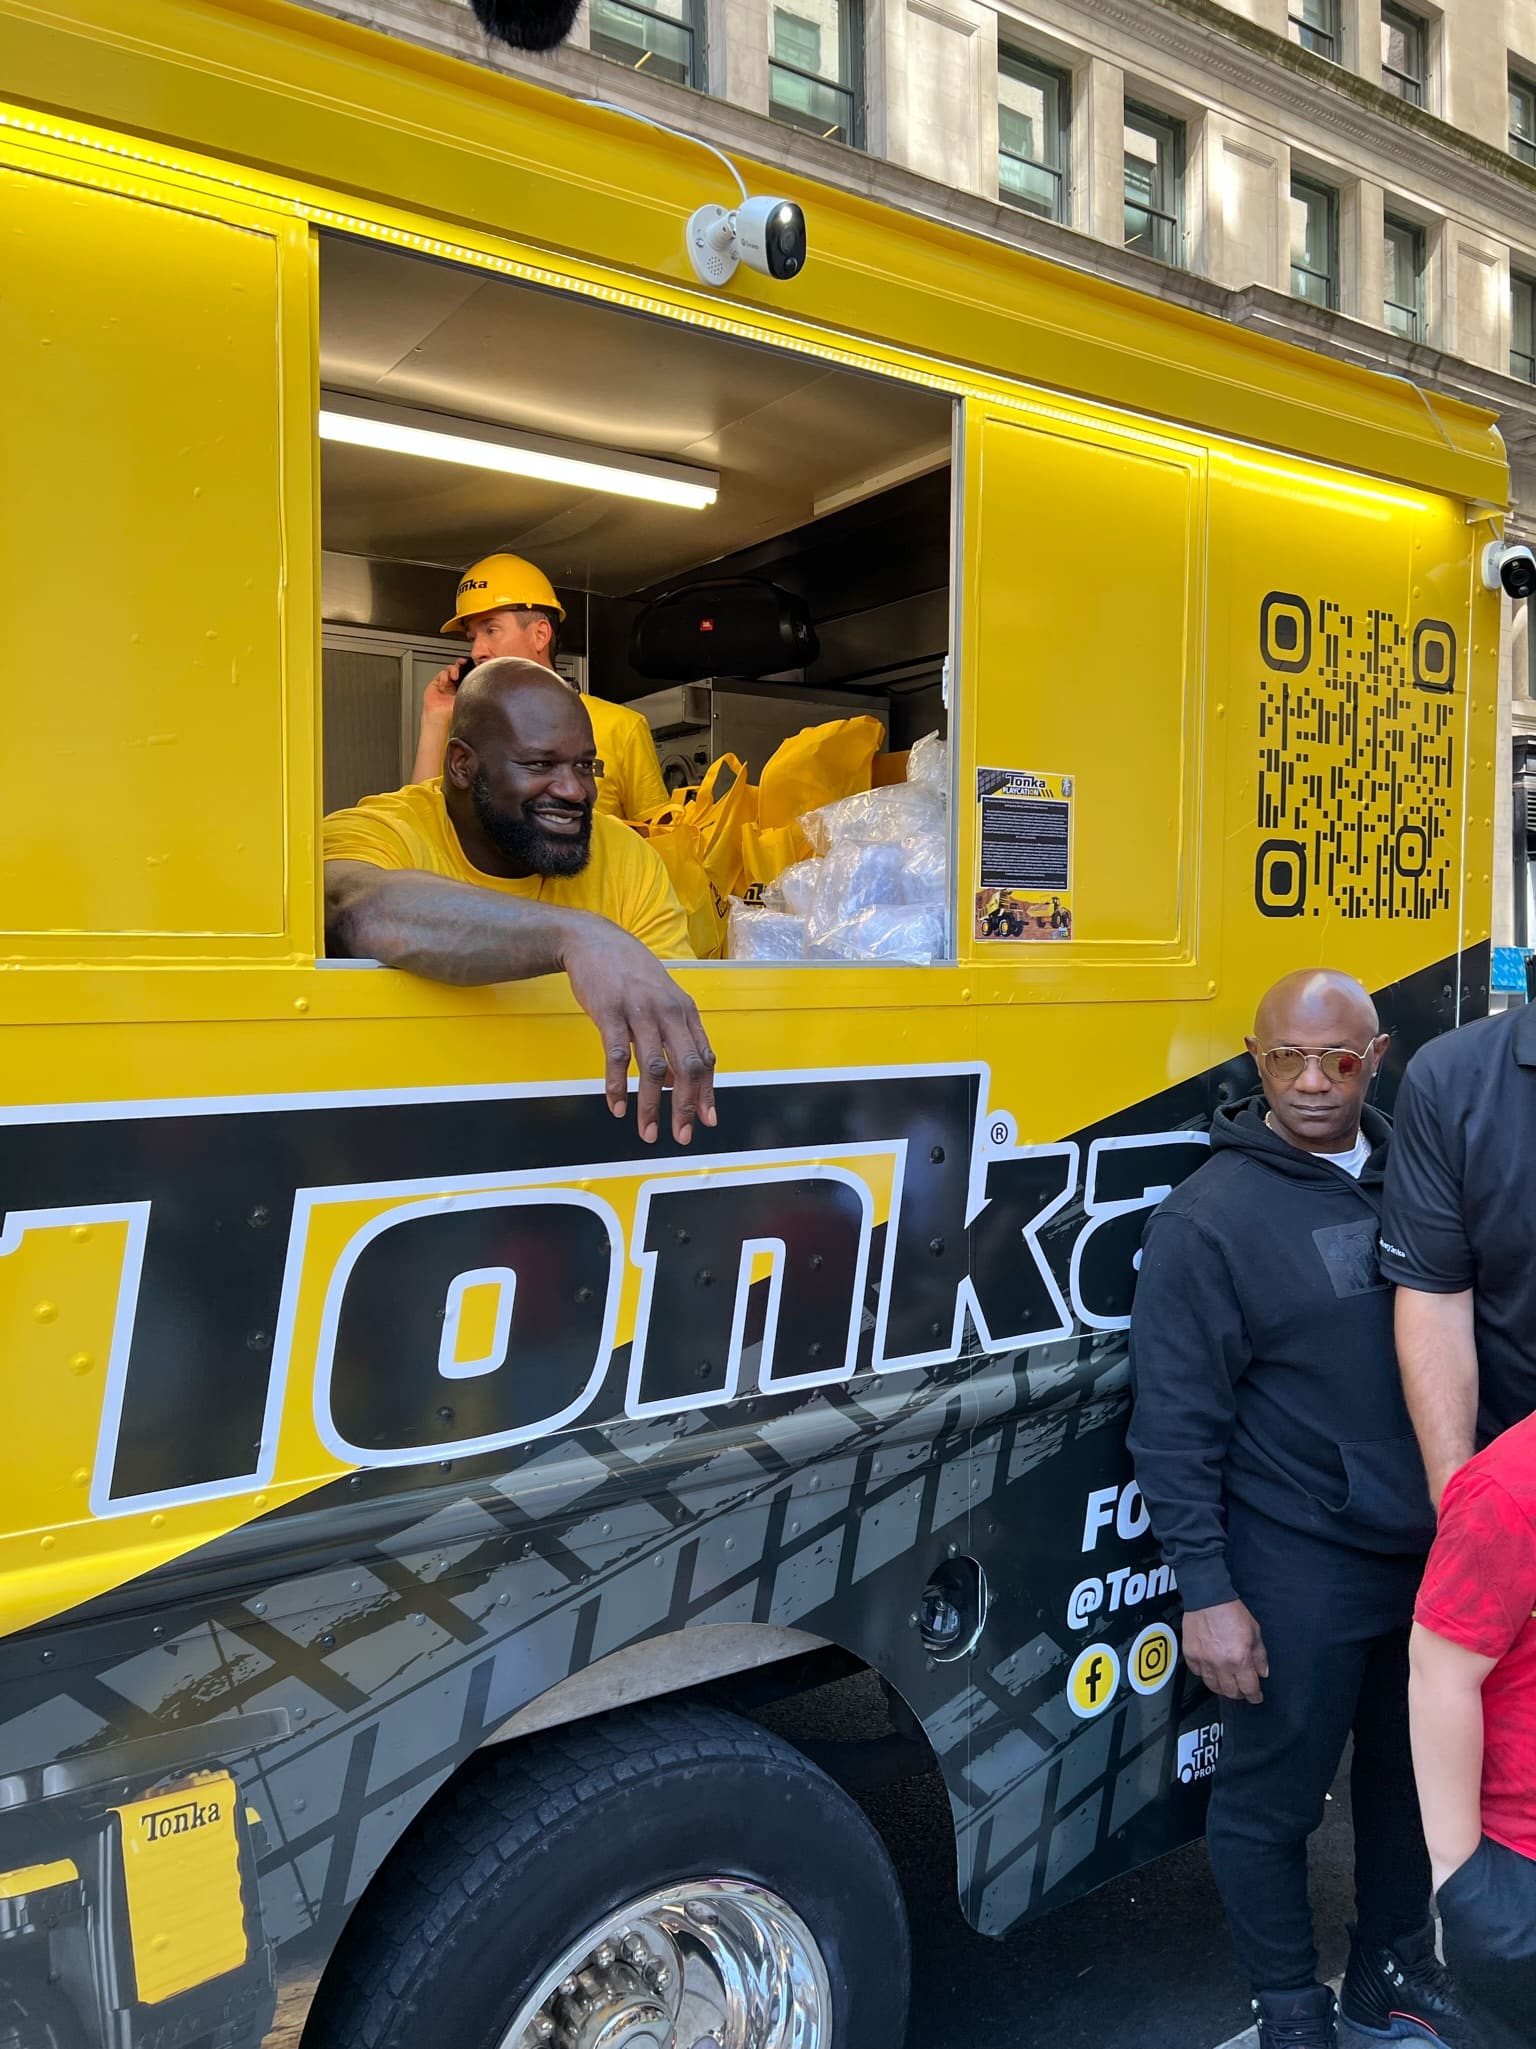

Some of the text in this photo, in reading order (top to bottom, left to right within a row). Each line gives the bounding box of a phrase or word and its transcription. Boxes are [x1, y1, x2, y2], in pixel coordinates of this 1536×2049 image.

[1003, 787, 1039, 796] PLAYCATION
[1006, 774, 1046, 788] Tonka
[1081, 1479, 1151, 1552] FO
[1200, 1720, 1224, 1747] FO
[141, 1801, 221, 1842] Tonka
